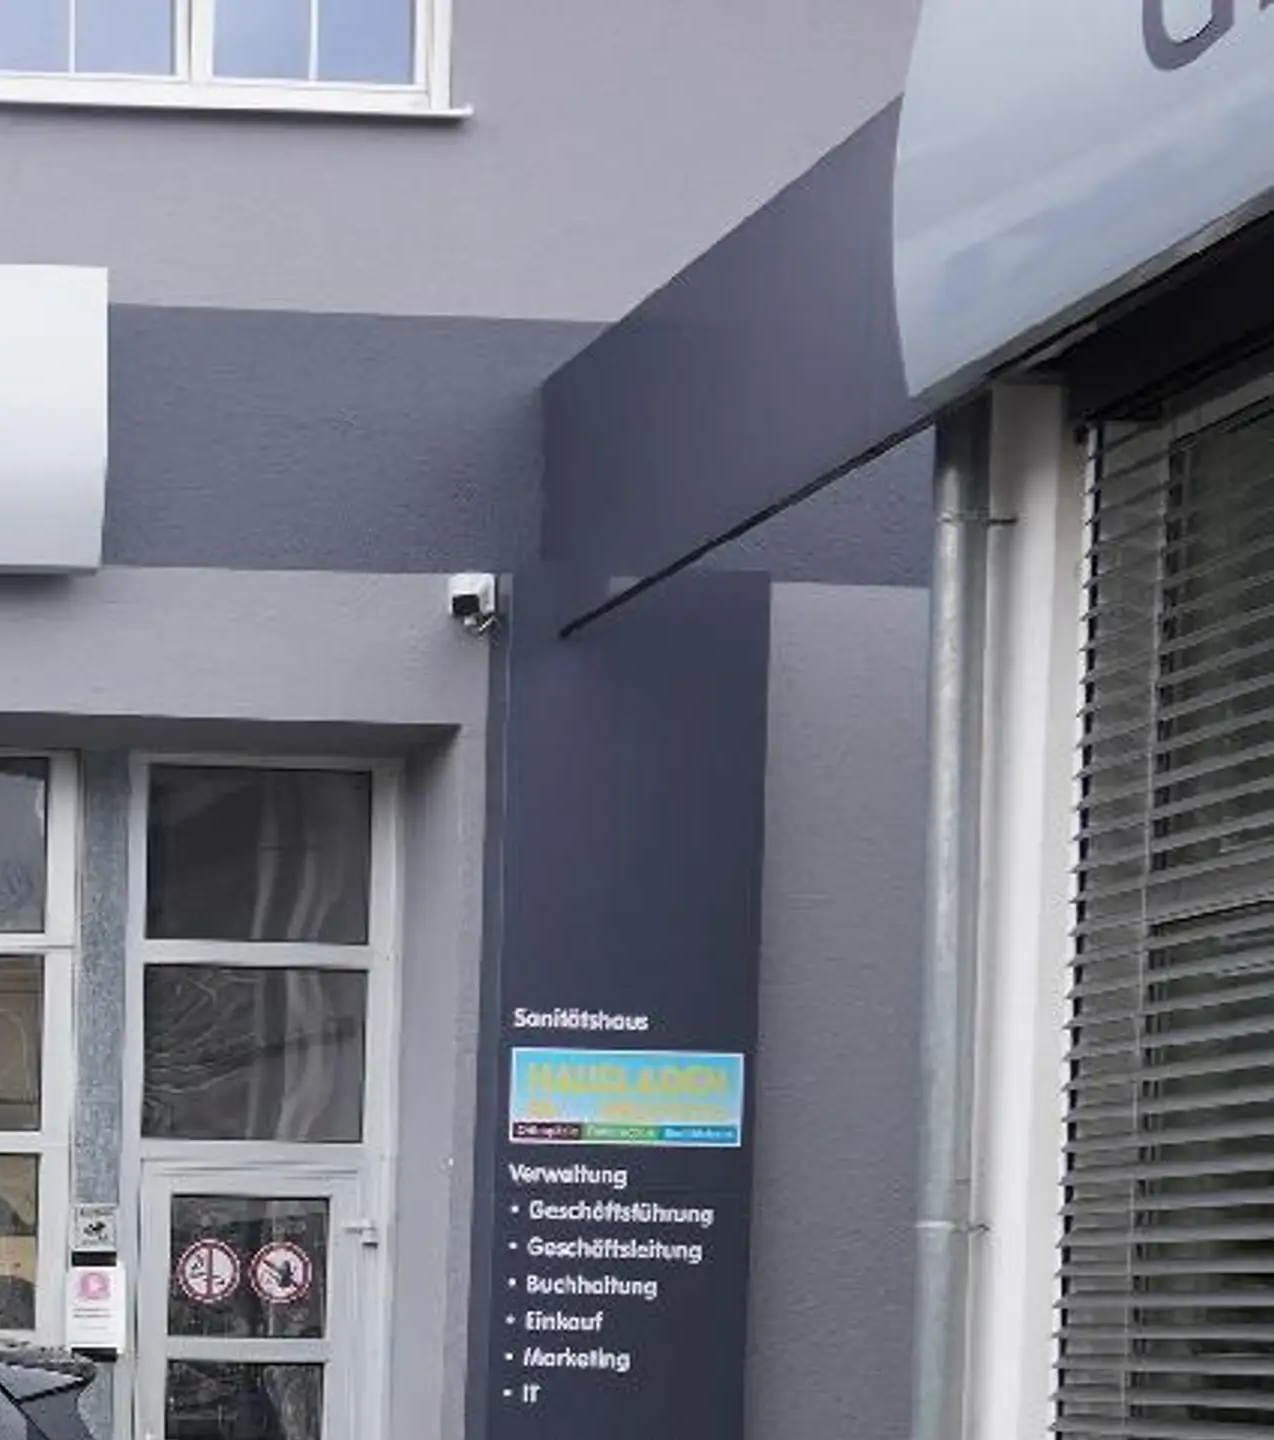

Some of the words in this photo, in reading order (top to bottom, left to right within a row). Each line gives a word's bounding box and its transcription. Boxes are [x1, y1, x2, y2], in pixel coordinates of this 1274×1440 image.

[514, 1008, 648, 1030] Sanitätshaus
[509, 1164, 627, 1189] Verwaltung
[530, 1200, 713, 1228] Geschäftsführung
[527, 1236, 702, 1264] Geschäftsleitung
[527, 1275, 657, 1300] Buchhaltung
[526, 1311, 603, 1330] Einkauf
[524, 1347, 630, 1372] Marketing
[524, 1384, 540, 1402] IT
